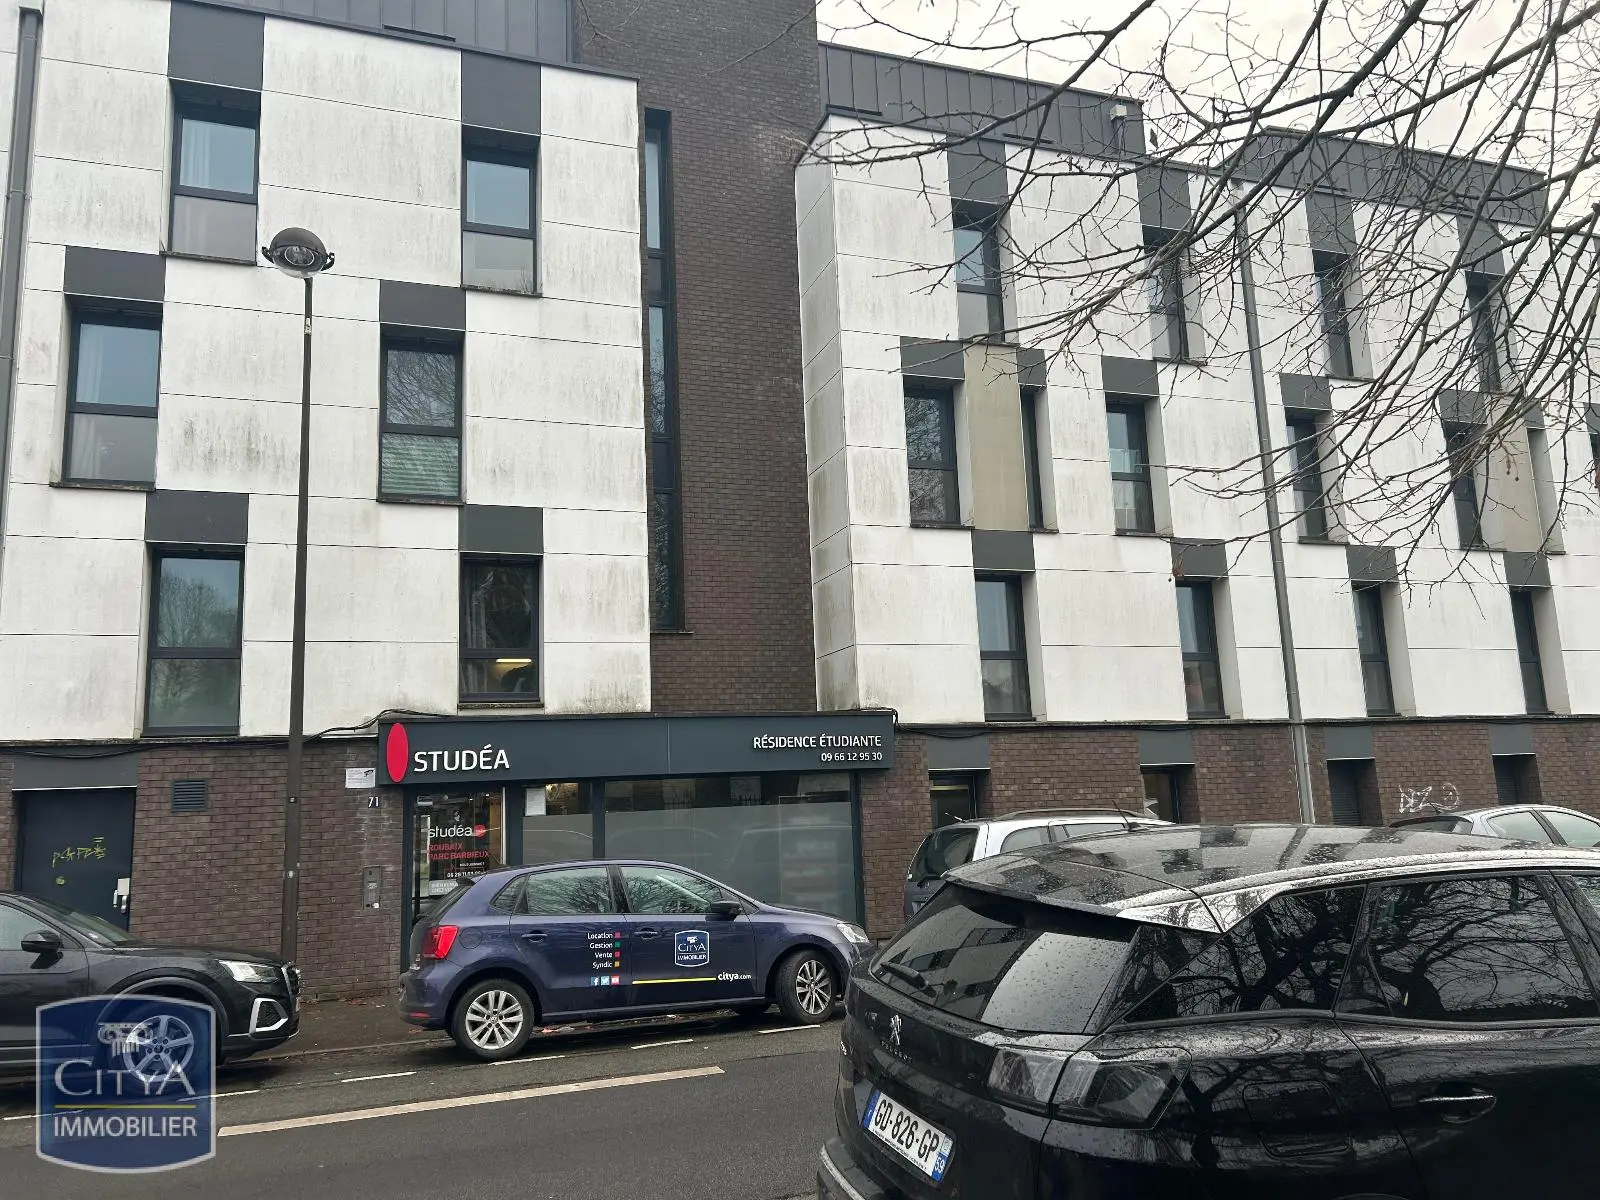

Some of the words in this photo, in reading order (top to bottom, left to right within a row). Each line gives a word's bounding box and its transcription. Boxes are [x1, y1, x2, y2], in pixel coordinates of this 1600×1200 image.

[753, 733, 817, 749] RÉSIDENCE
[819, 733, 882, 748] ÉTUDIANTE
[413, 743, 510, 772] STUDÉA
[821, 752, 833, 762] 09
[834, 752, 845, 761] 66
[847, 752, 857, 761] 12
[859, 752, 870, 761] 95
[872, 752, 882, 761] 30
[368, 796, 379, 808] 71
[428, 824, 473, 838] studéa
[428, 843, 463, 852] ROUBAIX
[428, 852, 450, 861] PARC
[450, 850, 489, 860] BARBIEUX
[587, 932, 613, 940] Location
[589, 941, 613, 949] Gestion
[592, 961, 613, 970] Syndic
[717, 971, 752, 982] citya.com
[874, 1099, 940, 1163] GD-826-GP
[934, 1156, 945, 1174] 59
